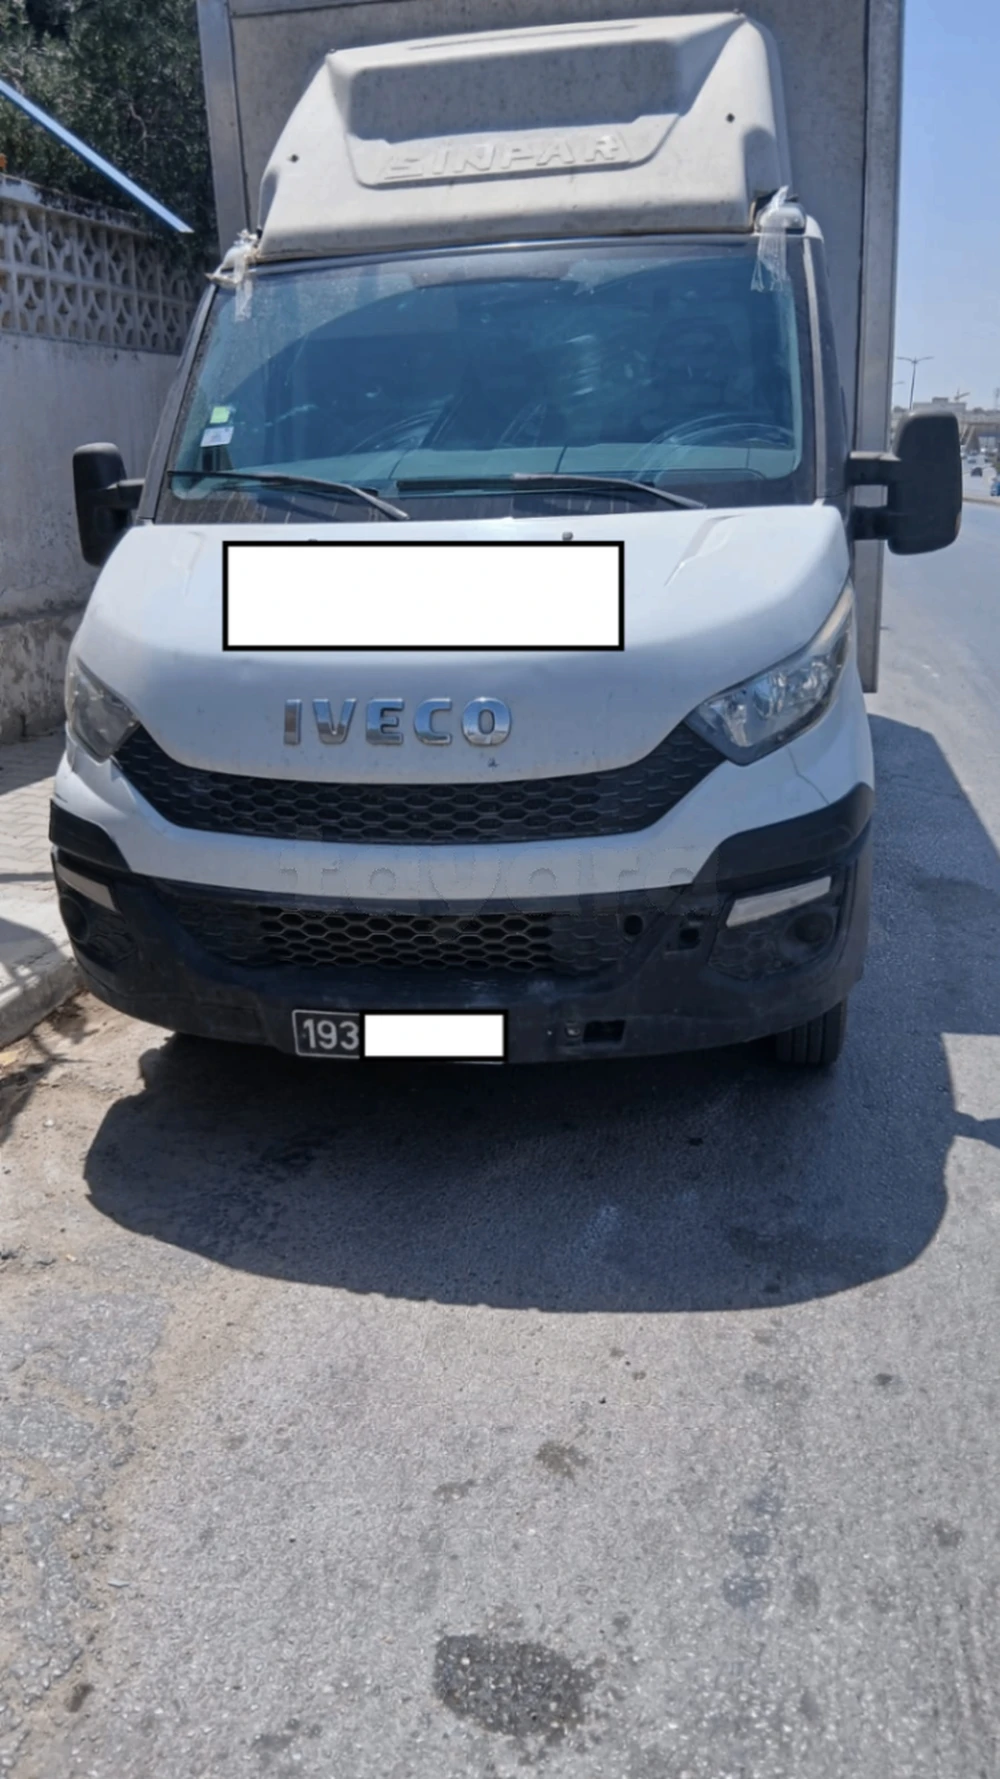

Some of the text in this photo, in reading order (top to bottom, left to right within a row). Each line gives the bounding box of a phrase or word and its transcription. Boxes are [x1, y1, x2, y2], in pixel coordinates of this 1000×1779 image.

[384, 134, 621, 179] SINPAR
[284, 696, 512, 746] IVECO
[303, 1018, 360, 1050] 193
